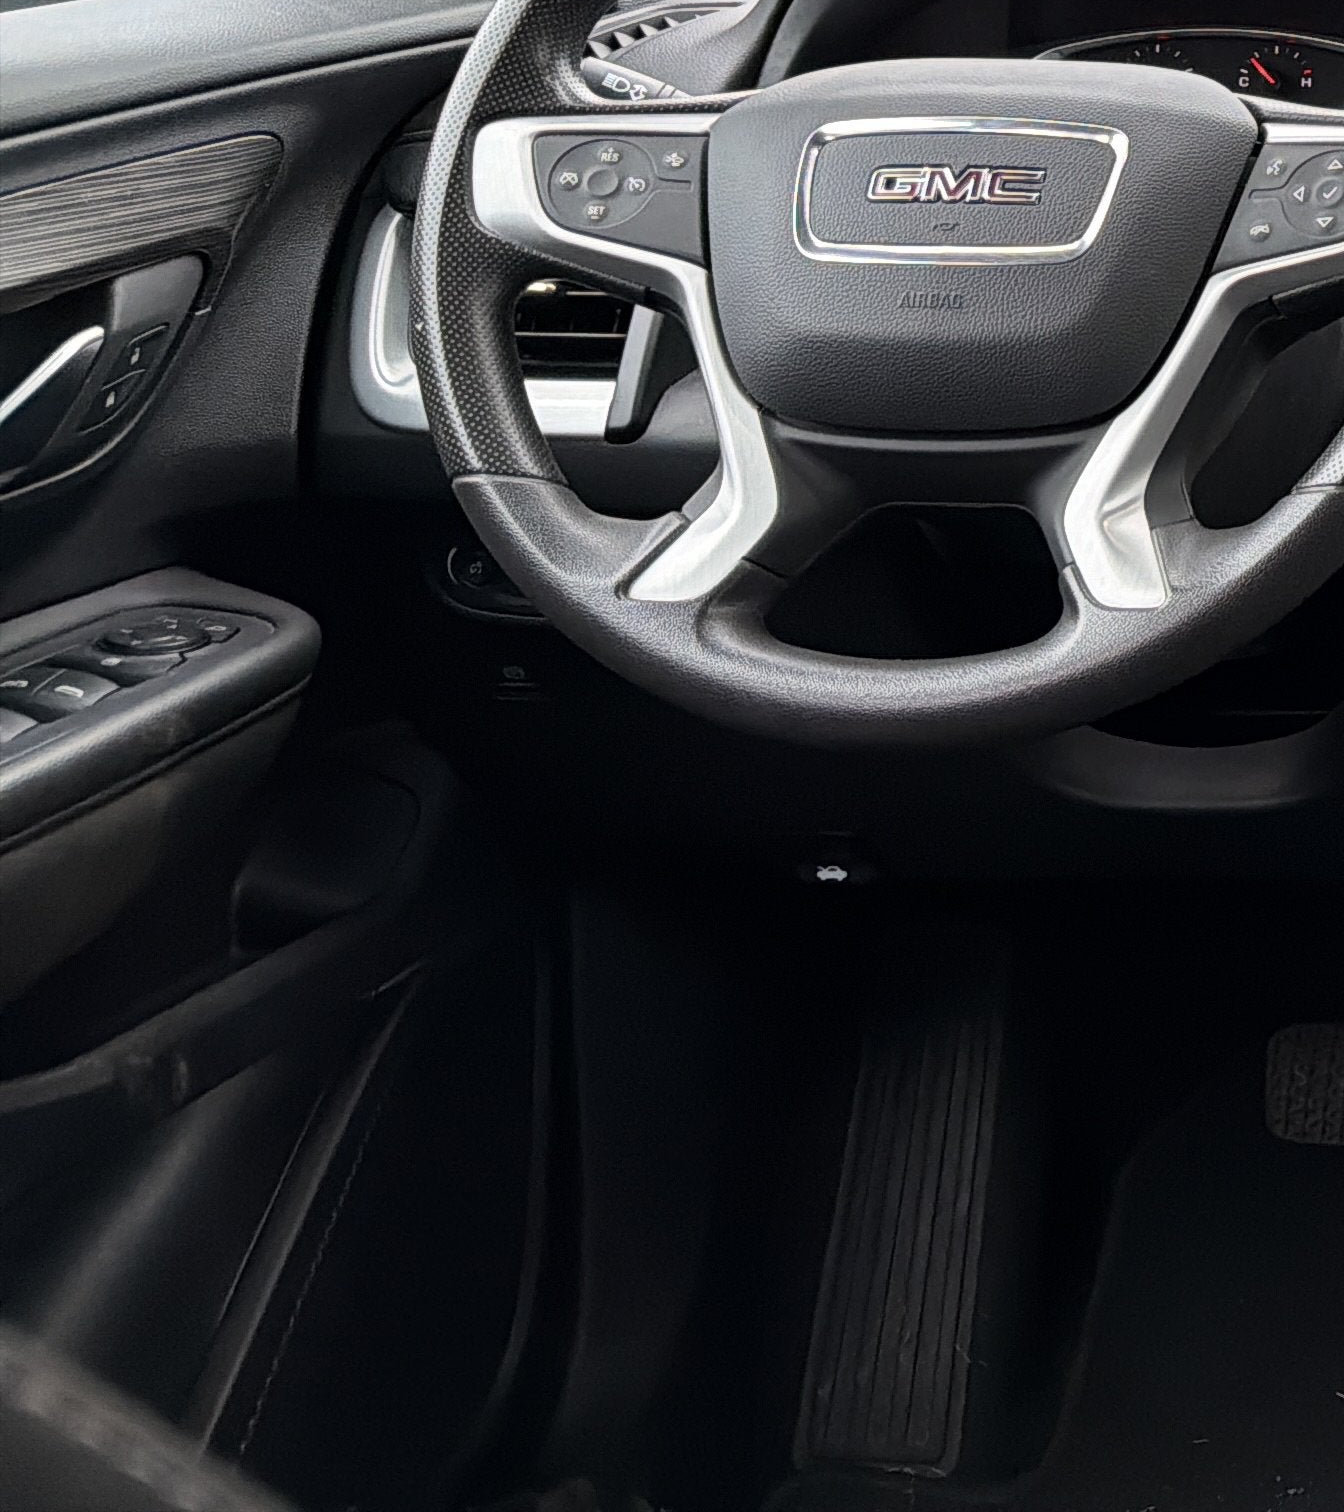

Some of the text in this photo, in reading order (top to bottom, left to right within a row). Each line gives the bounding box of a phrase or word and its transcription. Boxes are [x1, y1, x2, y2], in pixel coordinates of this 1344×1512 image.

[1239, 76, 1249, 87] C
[1302, 76, 1312, 87] H
[600, 151, 619, 163] RES
[865, 162, 1047, 207] GMC
[587, 204, 606, 216] SET
[898, 291, 965, 313] AIRBAG
